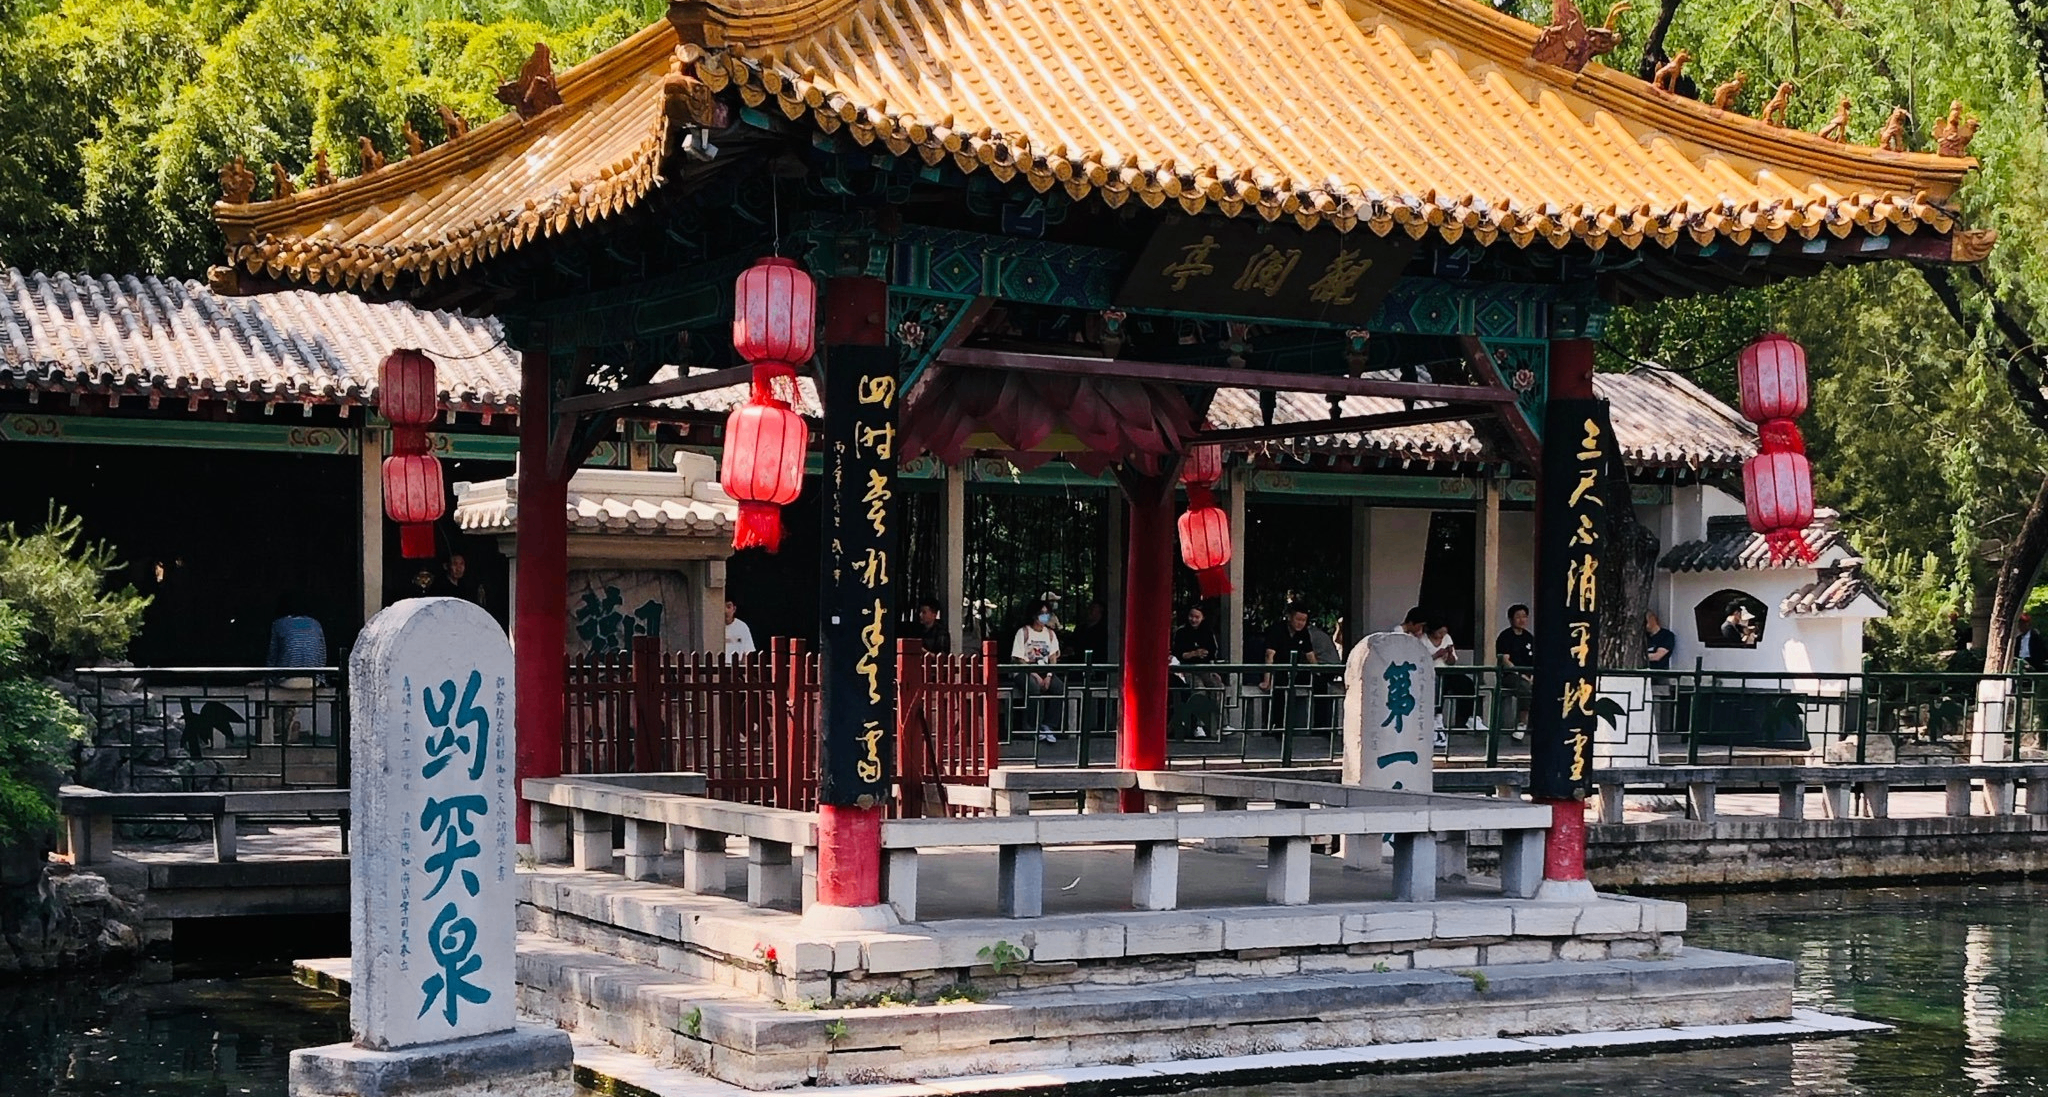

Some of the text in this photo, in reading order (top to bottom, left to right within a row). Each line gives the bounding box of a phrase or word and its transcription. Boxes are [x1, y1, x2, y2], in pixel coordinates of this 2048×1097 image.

[1376, 660, 1419, 790] 第一
[417, 669, 492, 1027] 趵突泉
